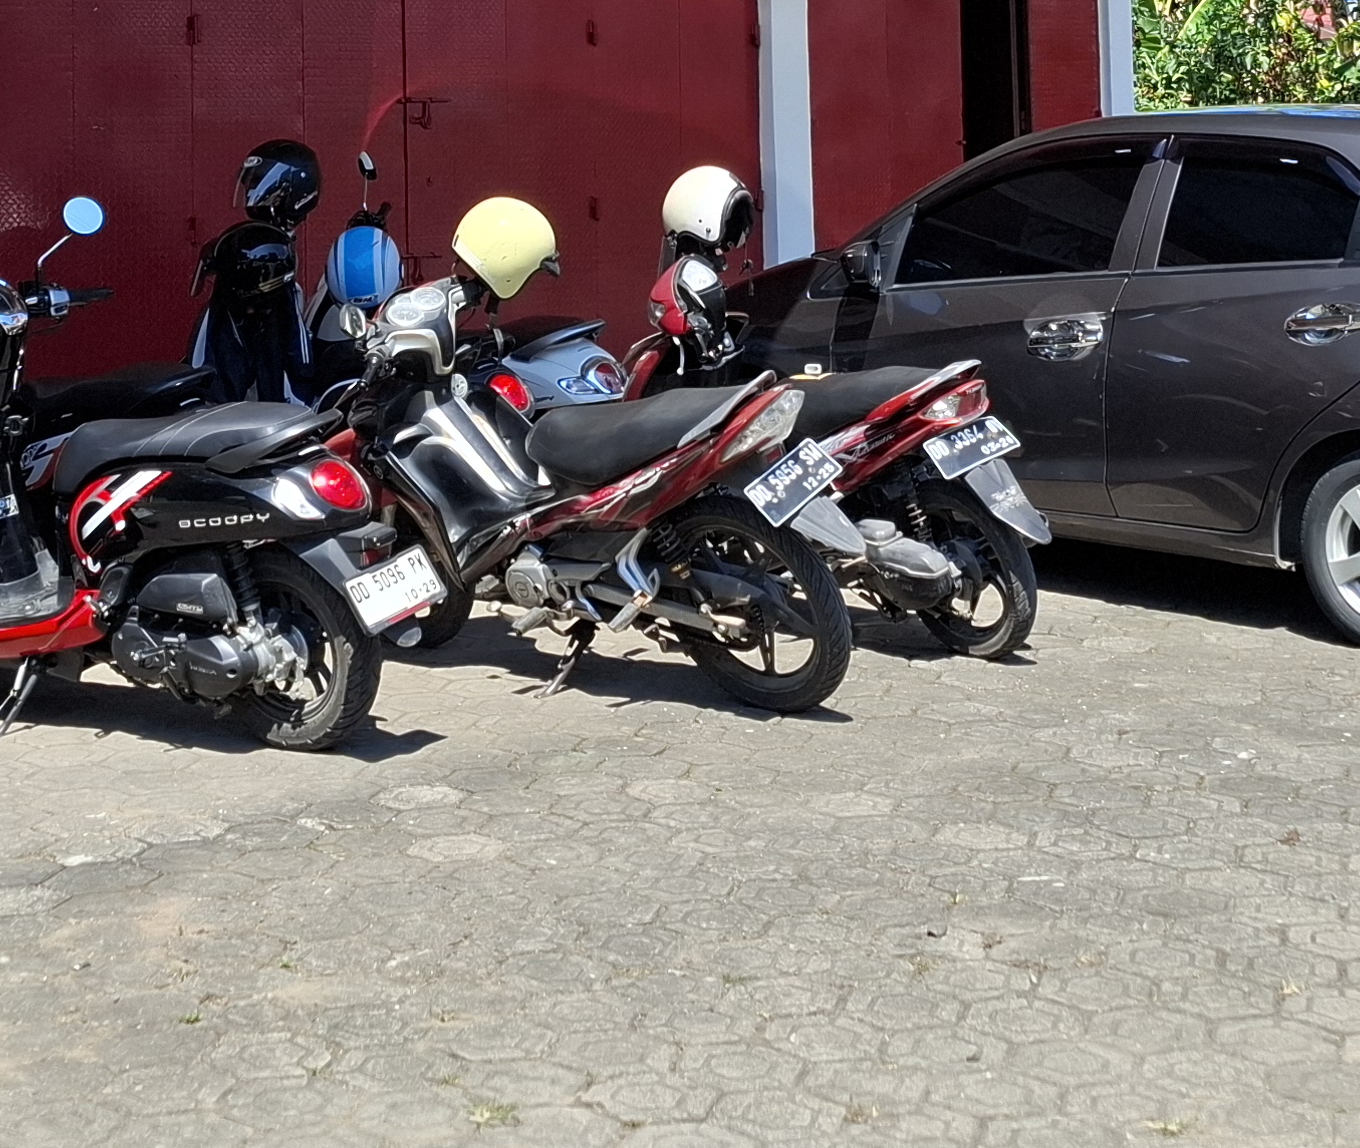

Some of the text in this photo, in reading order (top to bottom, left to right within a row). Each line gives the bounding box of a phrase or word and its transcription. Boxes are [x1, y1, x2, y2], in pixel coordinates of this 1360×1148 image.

[929, 441, 950, 460] DD
[749, 484, 772, 508] DD
[349, 552, 428, 604] DD 5096 PK
